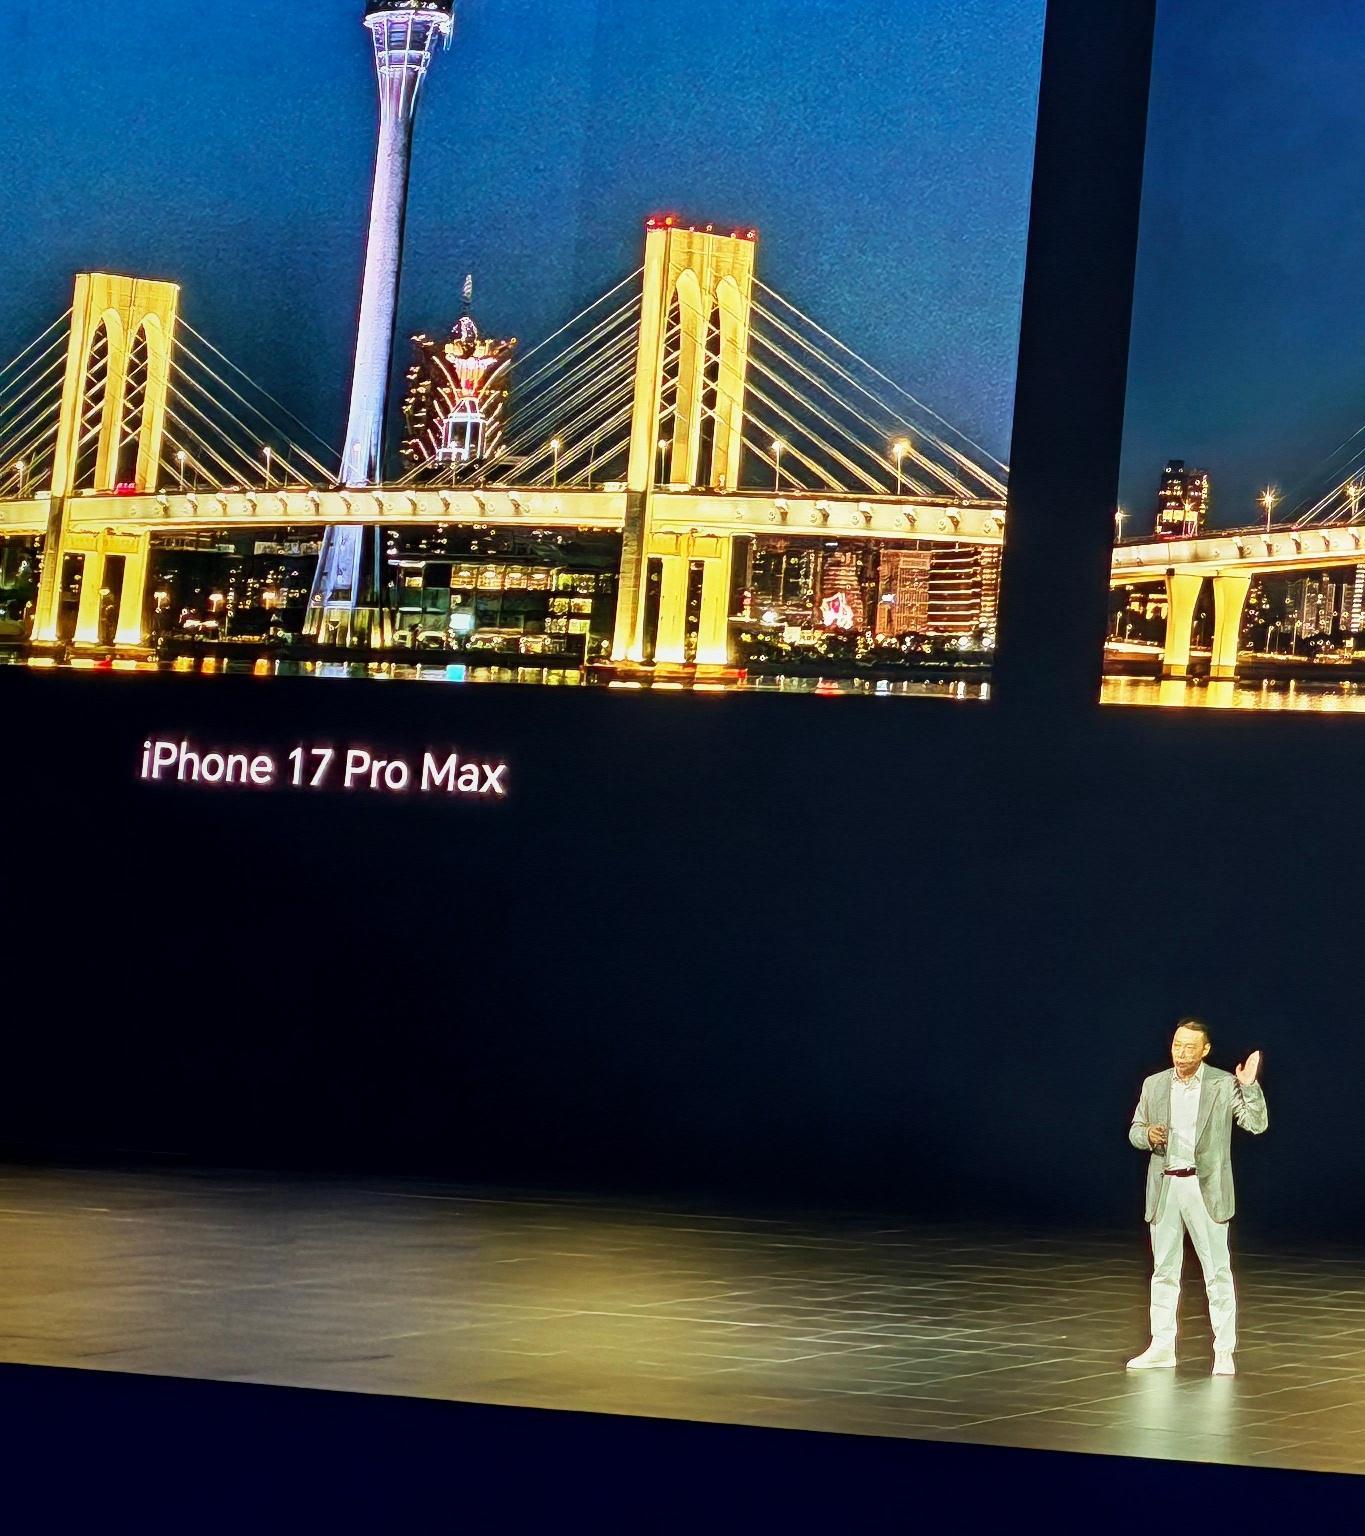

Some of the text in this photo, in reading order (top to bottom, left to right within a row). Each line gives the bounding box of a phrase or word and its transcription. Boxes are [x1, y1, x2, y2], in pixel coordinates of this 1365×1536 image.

[140, 740, 508, 794] iPhone 17 Pro Max
